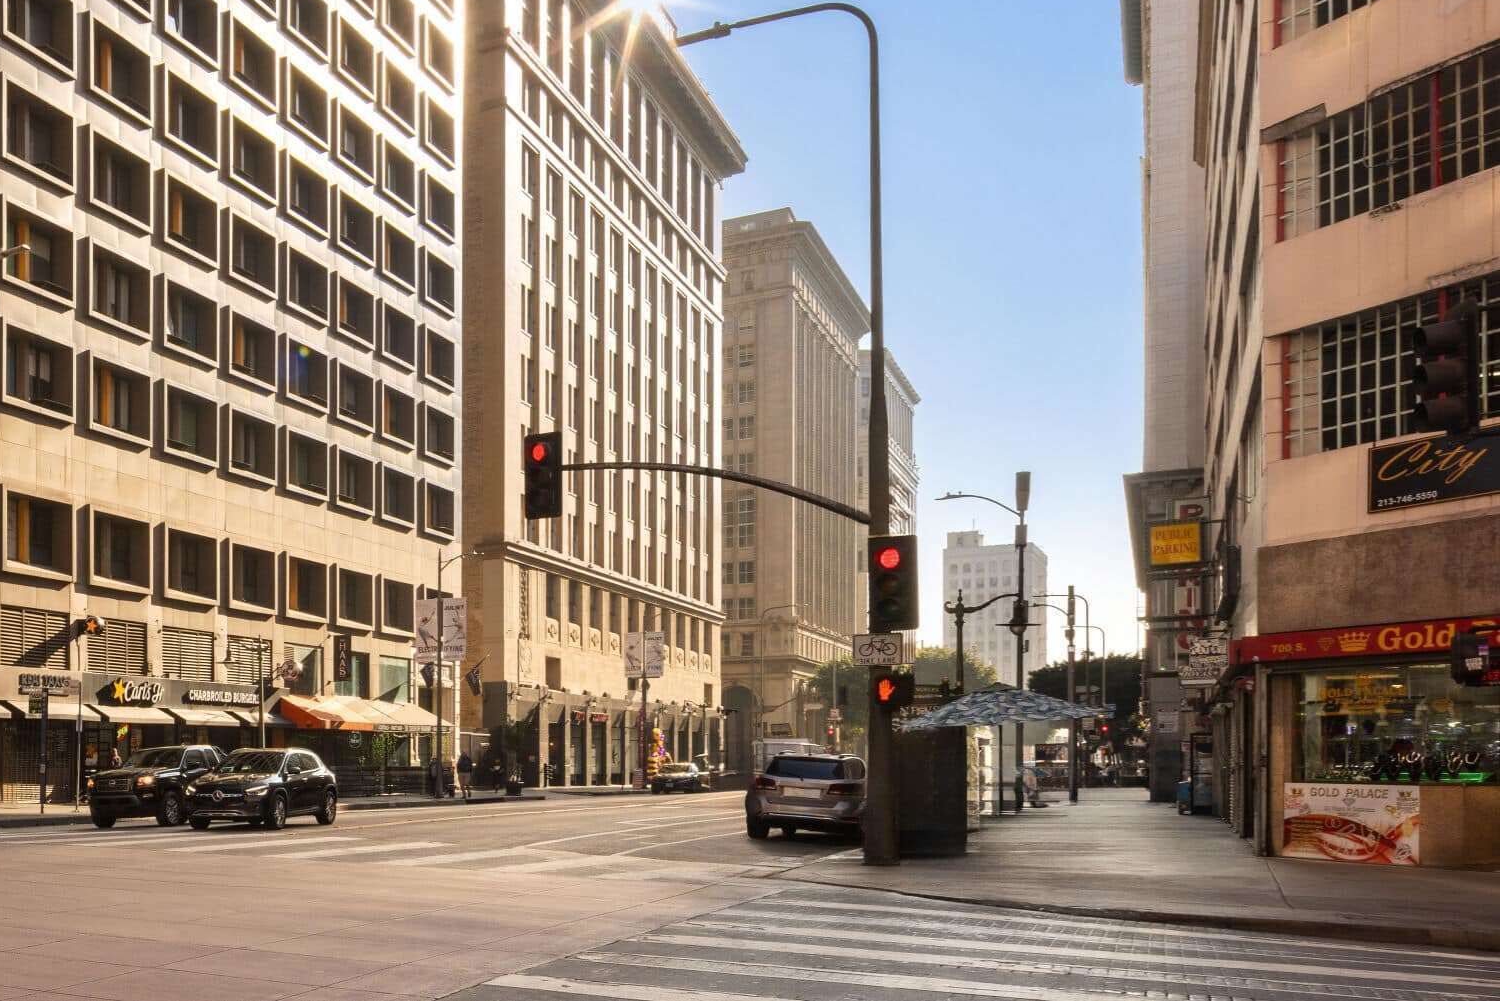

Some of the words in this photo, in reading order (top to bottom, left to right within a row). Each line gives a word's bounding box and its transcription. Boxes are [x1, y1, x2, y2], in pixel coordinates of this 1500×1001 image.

[1377, 440, 1488, 485] City
[1154, 527, 1195, 541] PUBLIC
[1153, 541, 1197, 556] PARKING
[1377, 623, 1456, 651] Gold
[339, 642, 347, 676] HAAS
[189, 689, 232, 703] CHARBROILED
[1310, 787, 1340, 797] GOLD
[1345, 788, 1389, 799] PALACE
